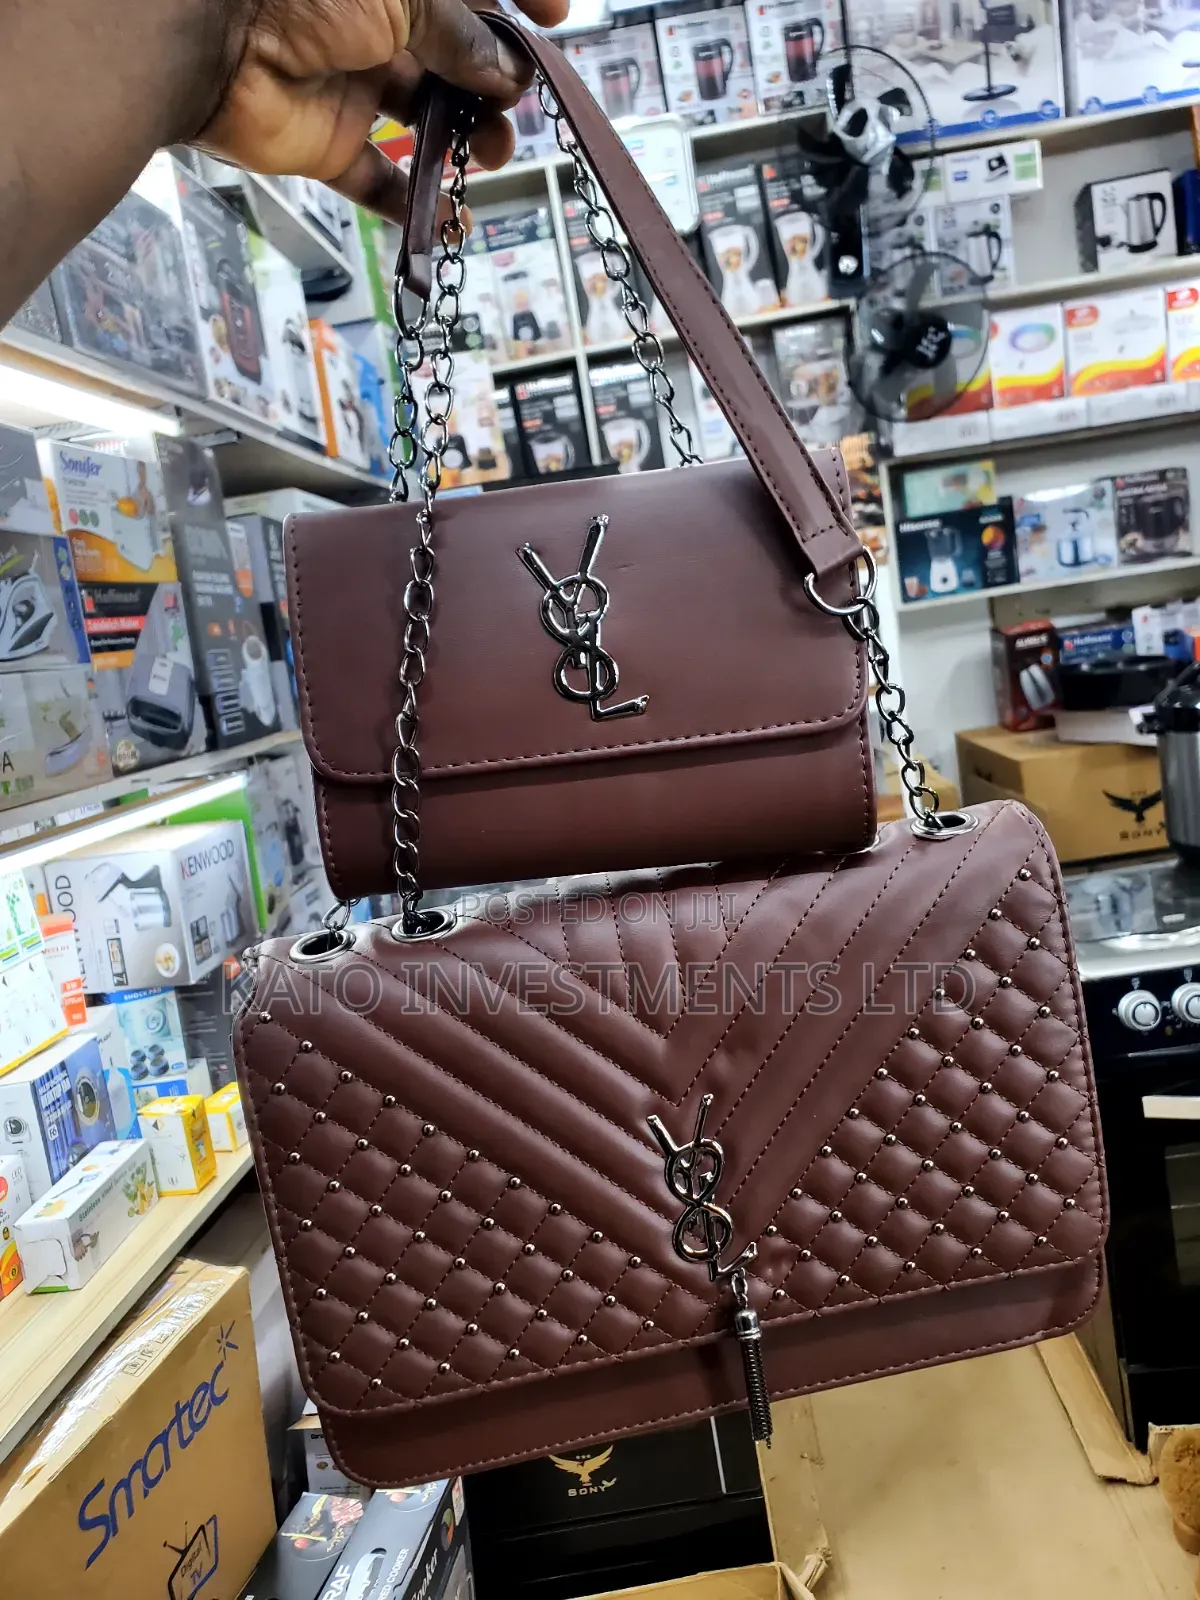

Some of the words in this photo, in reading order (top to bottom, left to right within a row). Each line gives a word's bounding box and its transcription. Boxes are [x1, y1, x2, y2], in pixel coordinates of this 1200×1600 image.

[59, 451, 102, 478] Sonifer
[180, 839, 235, 881] KENWOOD
[78, 1360, 229, 1571] Smartec
[568, 1486, 606, 1497] SONY
[322, 1564, 351, 1600] RAF
[387, 1548, 410, 1583] COOKER
